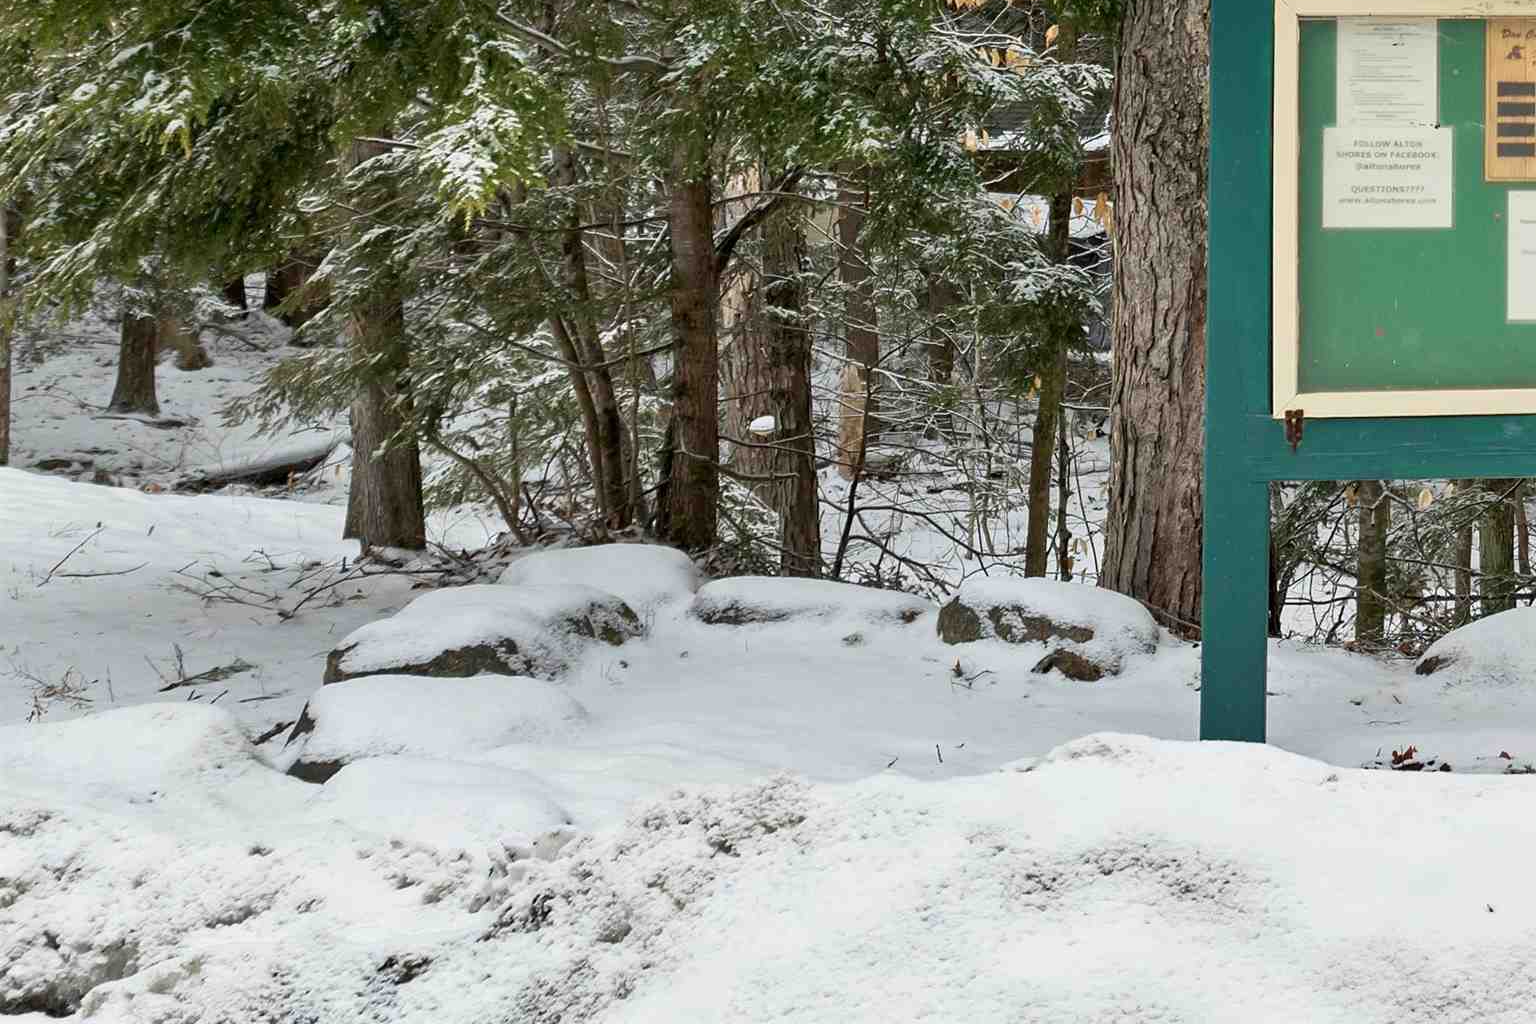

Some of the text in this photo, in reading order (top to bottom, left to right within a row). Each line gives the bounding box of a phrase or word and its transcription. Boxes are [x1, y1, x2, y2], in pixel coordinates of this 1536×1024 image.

[1352, 139, 1423, 148] FOLLOW ALTON
[1336, 150, 1372, 159] SHORES
[1374, 150, 1388, 159] ON
